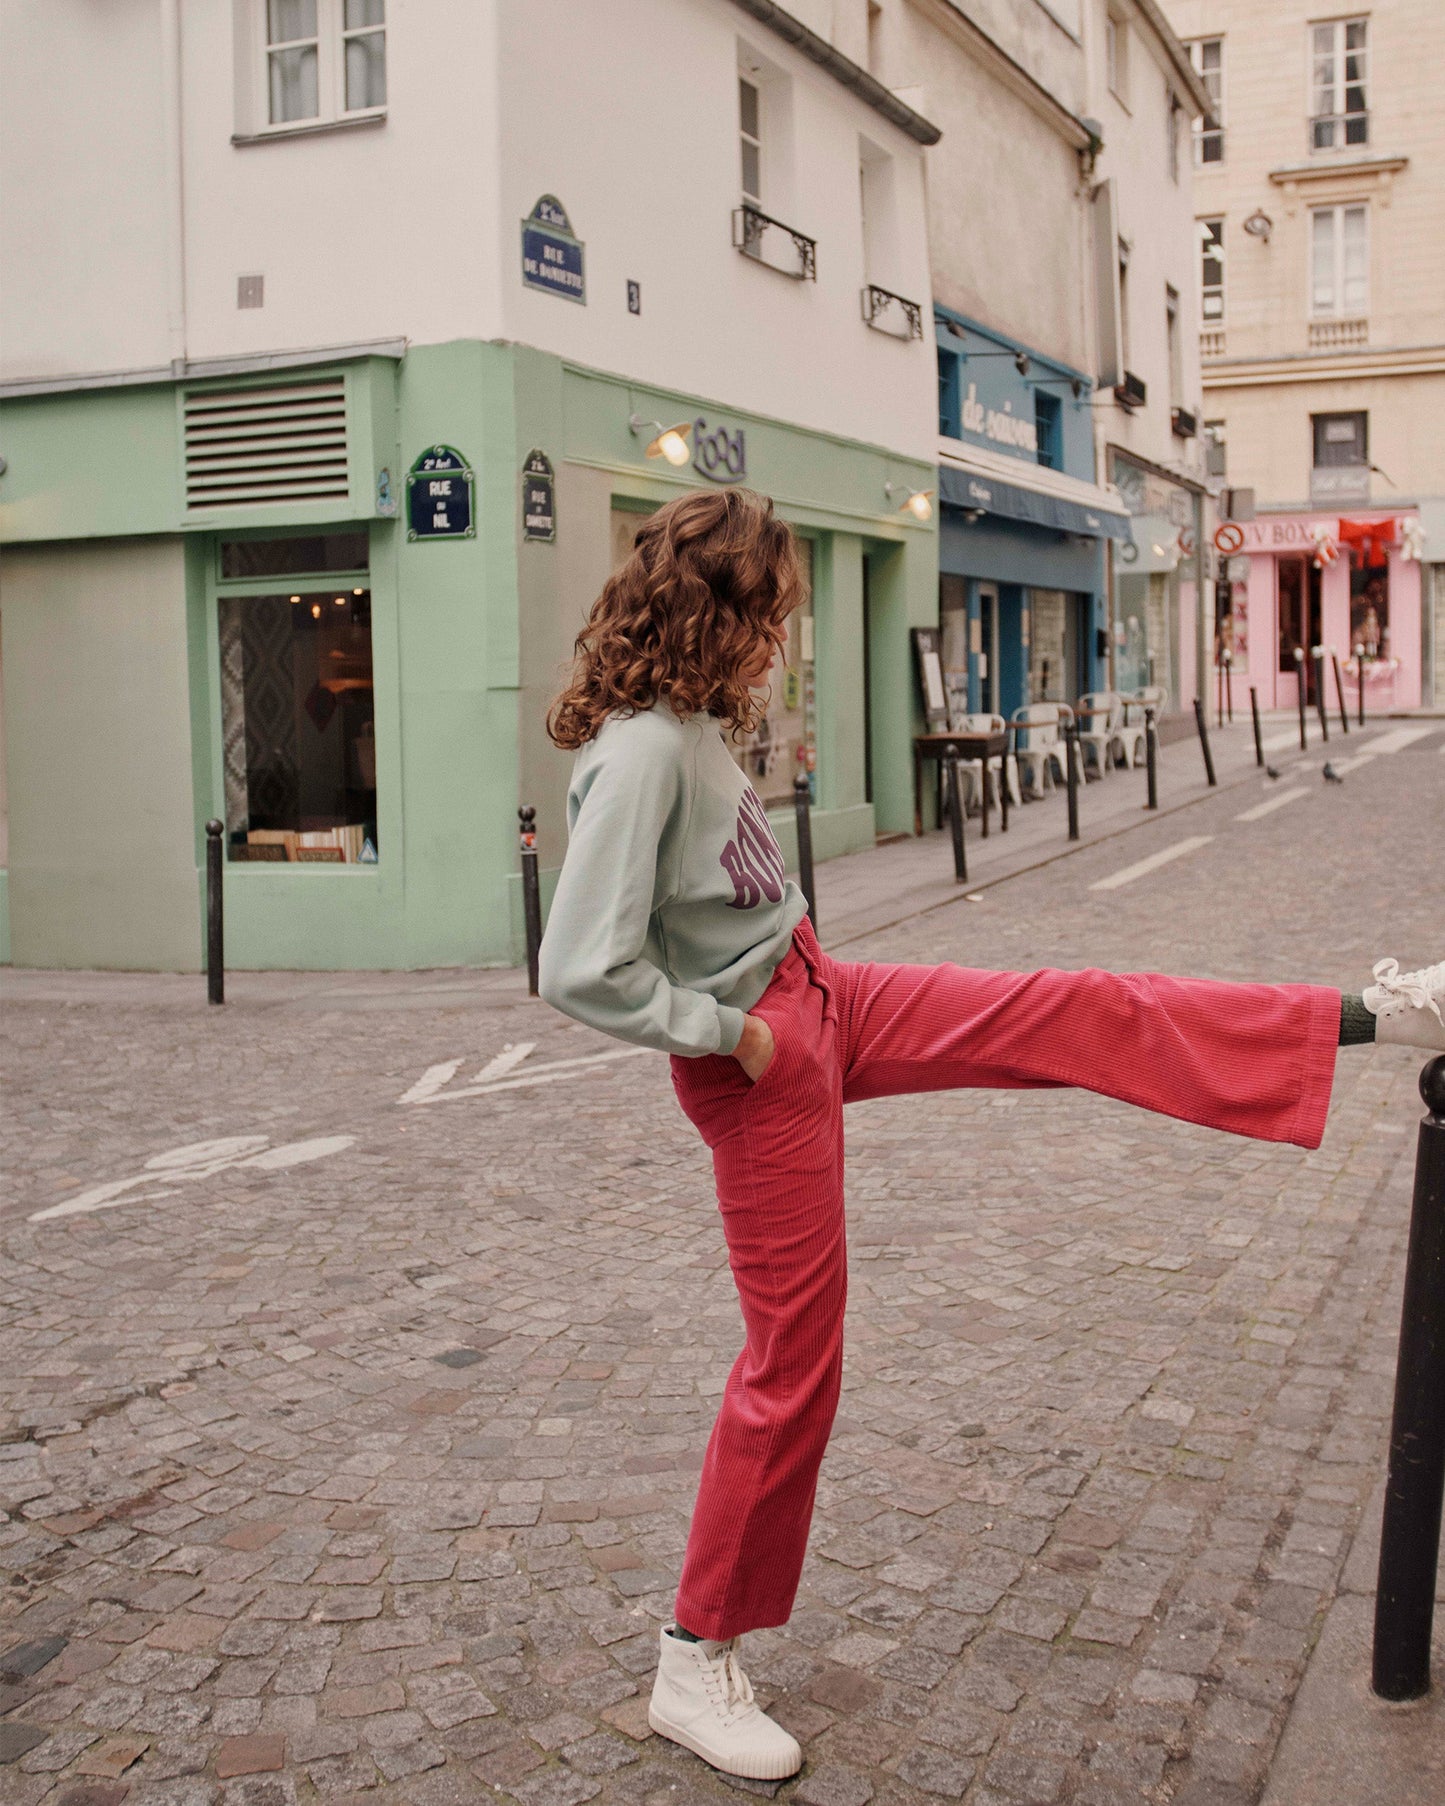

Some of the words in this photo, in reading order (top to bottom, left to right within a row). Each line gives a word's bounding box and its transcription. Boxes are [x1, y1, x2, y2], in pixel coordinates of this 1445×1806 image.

[543, 244, 564, 265] RUE
[629, 284, 639, 311] 3
[962, 383, 984, 434] de
[429, 480, 452, 497] RUE
[531, 489, 546, 504] RUE
[432, 513, 451, 528] NIL
[1272, 523, 1310, 545] BOX
